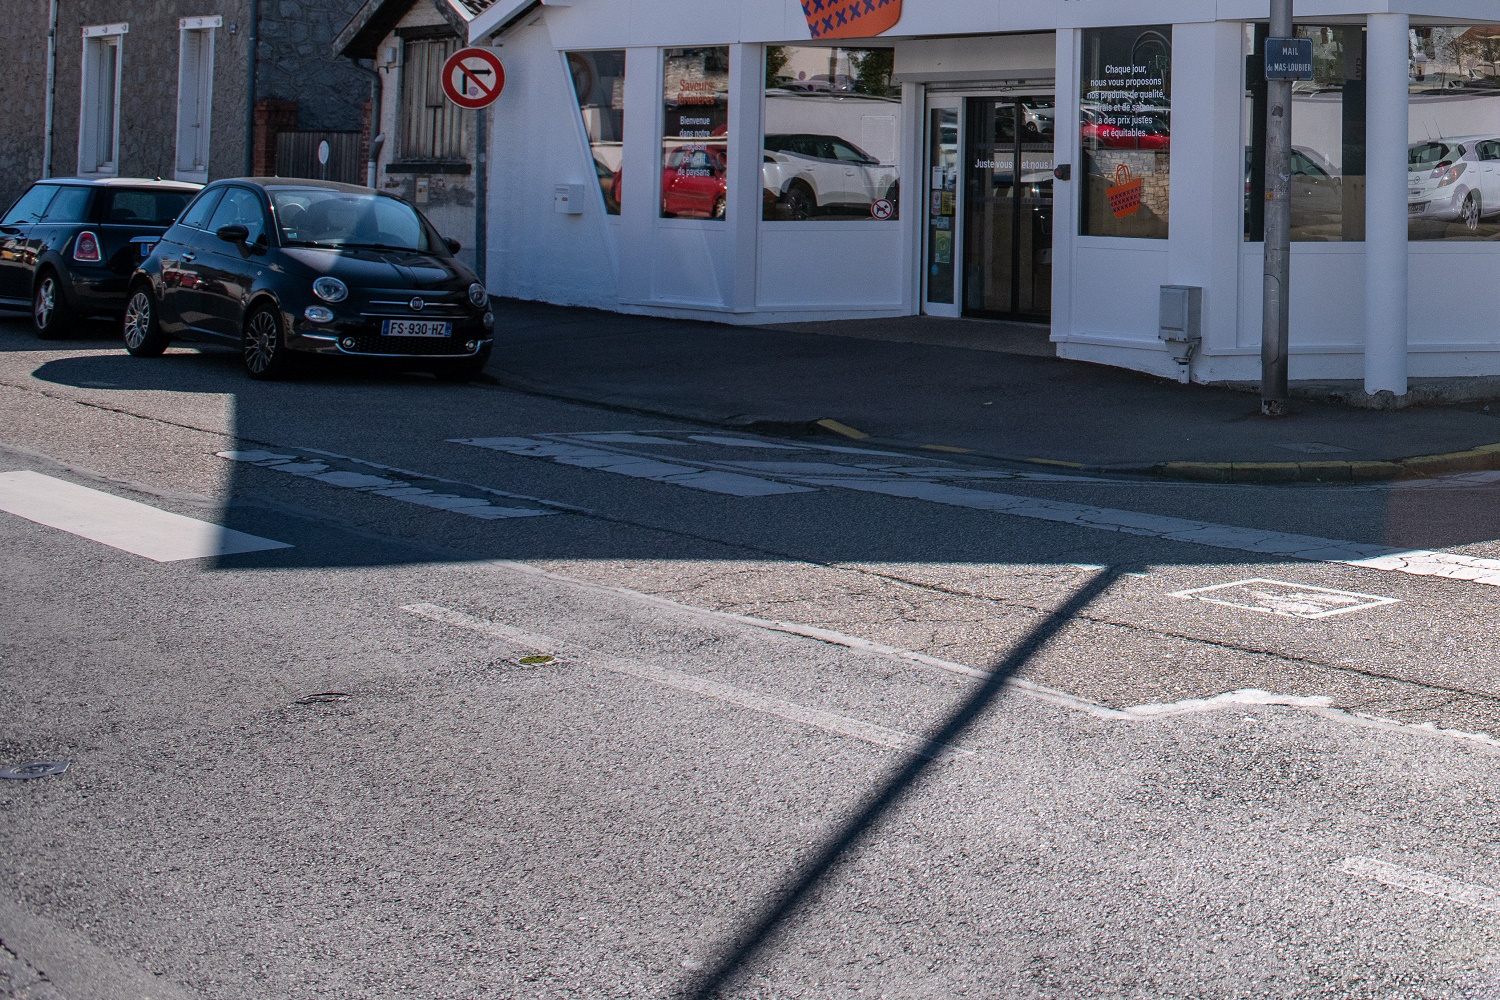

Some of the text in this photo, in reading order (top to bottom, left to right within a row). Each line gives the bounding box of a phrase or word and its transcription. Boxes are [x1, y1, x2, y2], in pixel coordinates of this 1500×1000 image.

[1282, 47, 1299, 56] MAIL
[1105, 64, 1147, 75] Chaque jour,
[1274, 63, 1312, 72] MAS-LOUBIER
[680, 79, 713, 92] Saveurs
[1125, 78, 1162, 87] proposons
[677, 93, 714, 105] fermières
[1100, 90, 1128, 101] produits
[1129, 90, 1138, 99] de
[1139, 89, 1165, 100] qualité,
[1121, 102, 1131, 111] de
[680, 116, 711, 125] Bienvenue
[1098, 115, 1153, 127] à des prix justes
[680, 128, 711, 138] dans notre
[1110, 128, 1148, 139] équitables.
[975, 159, 995, 169] Juste
[996, 161, 1013, 169] vous
[1022, 161, 1029, 169] et
[1030, 161, 1049, 170] nous
[677, 166, 711, 179] de paysans
[390, 322, 445, 335] FS-930-HZ
